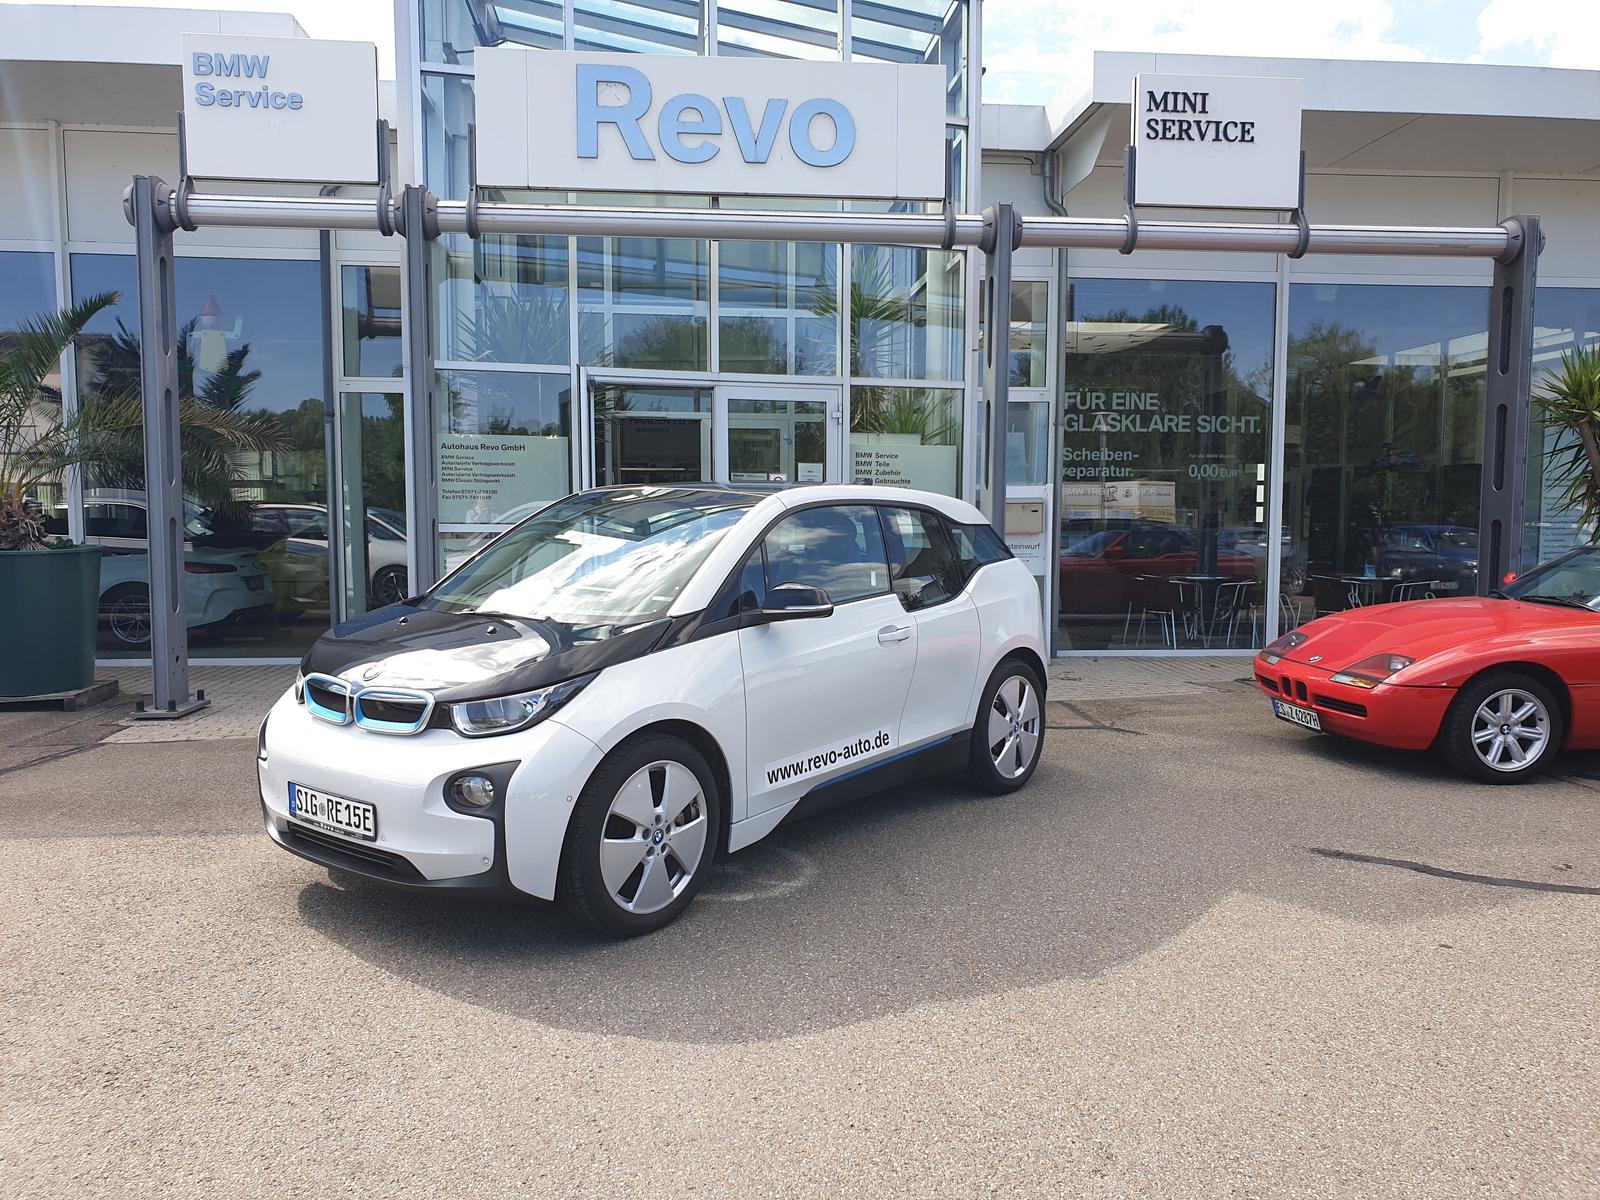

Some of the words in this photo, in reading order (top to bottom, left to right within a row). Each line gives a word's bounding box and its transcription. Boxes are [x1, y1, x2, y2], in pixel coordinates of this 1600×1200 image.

[192, 52, 270, 78] BMW
[195, 82, 304, 110] Service
[1146, 90, 1209, 114] MINI
[575, 63, 856, 168] Revo
[1146, 118, 1255, 143] SERVICE
[1064, 387, 1105, 410] FÜR
[1112, 391, 1160, 411] EINE
[1063, 413, 1191, 433] GLASKLARE
[1196, 415, 1262, 434] SICHT.
[441, 442, 479, 451] Autohaus
[480, 443, 500, 451] Revo
[501, 444, 526, 452] GmbH
[1063, 447, 1140, 461] Scheiben-
[874, 477, 911, 485] Gebrauchte
[1062, 464, 1134, 480] reparatur.
[1188, 464, 1219, 480] 0,00
[767, 730, 890, 784] www.revo-auto.de
[296, 788, 318, 817] SIG
